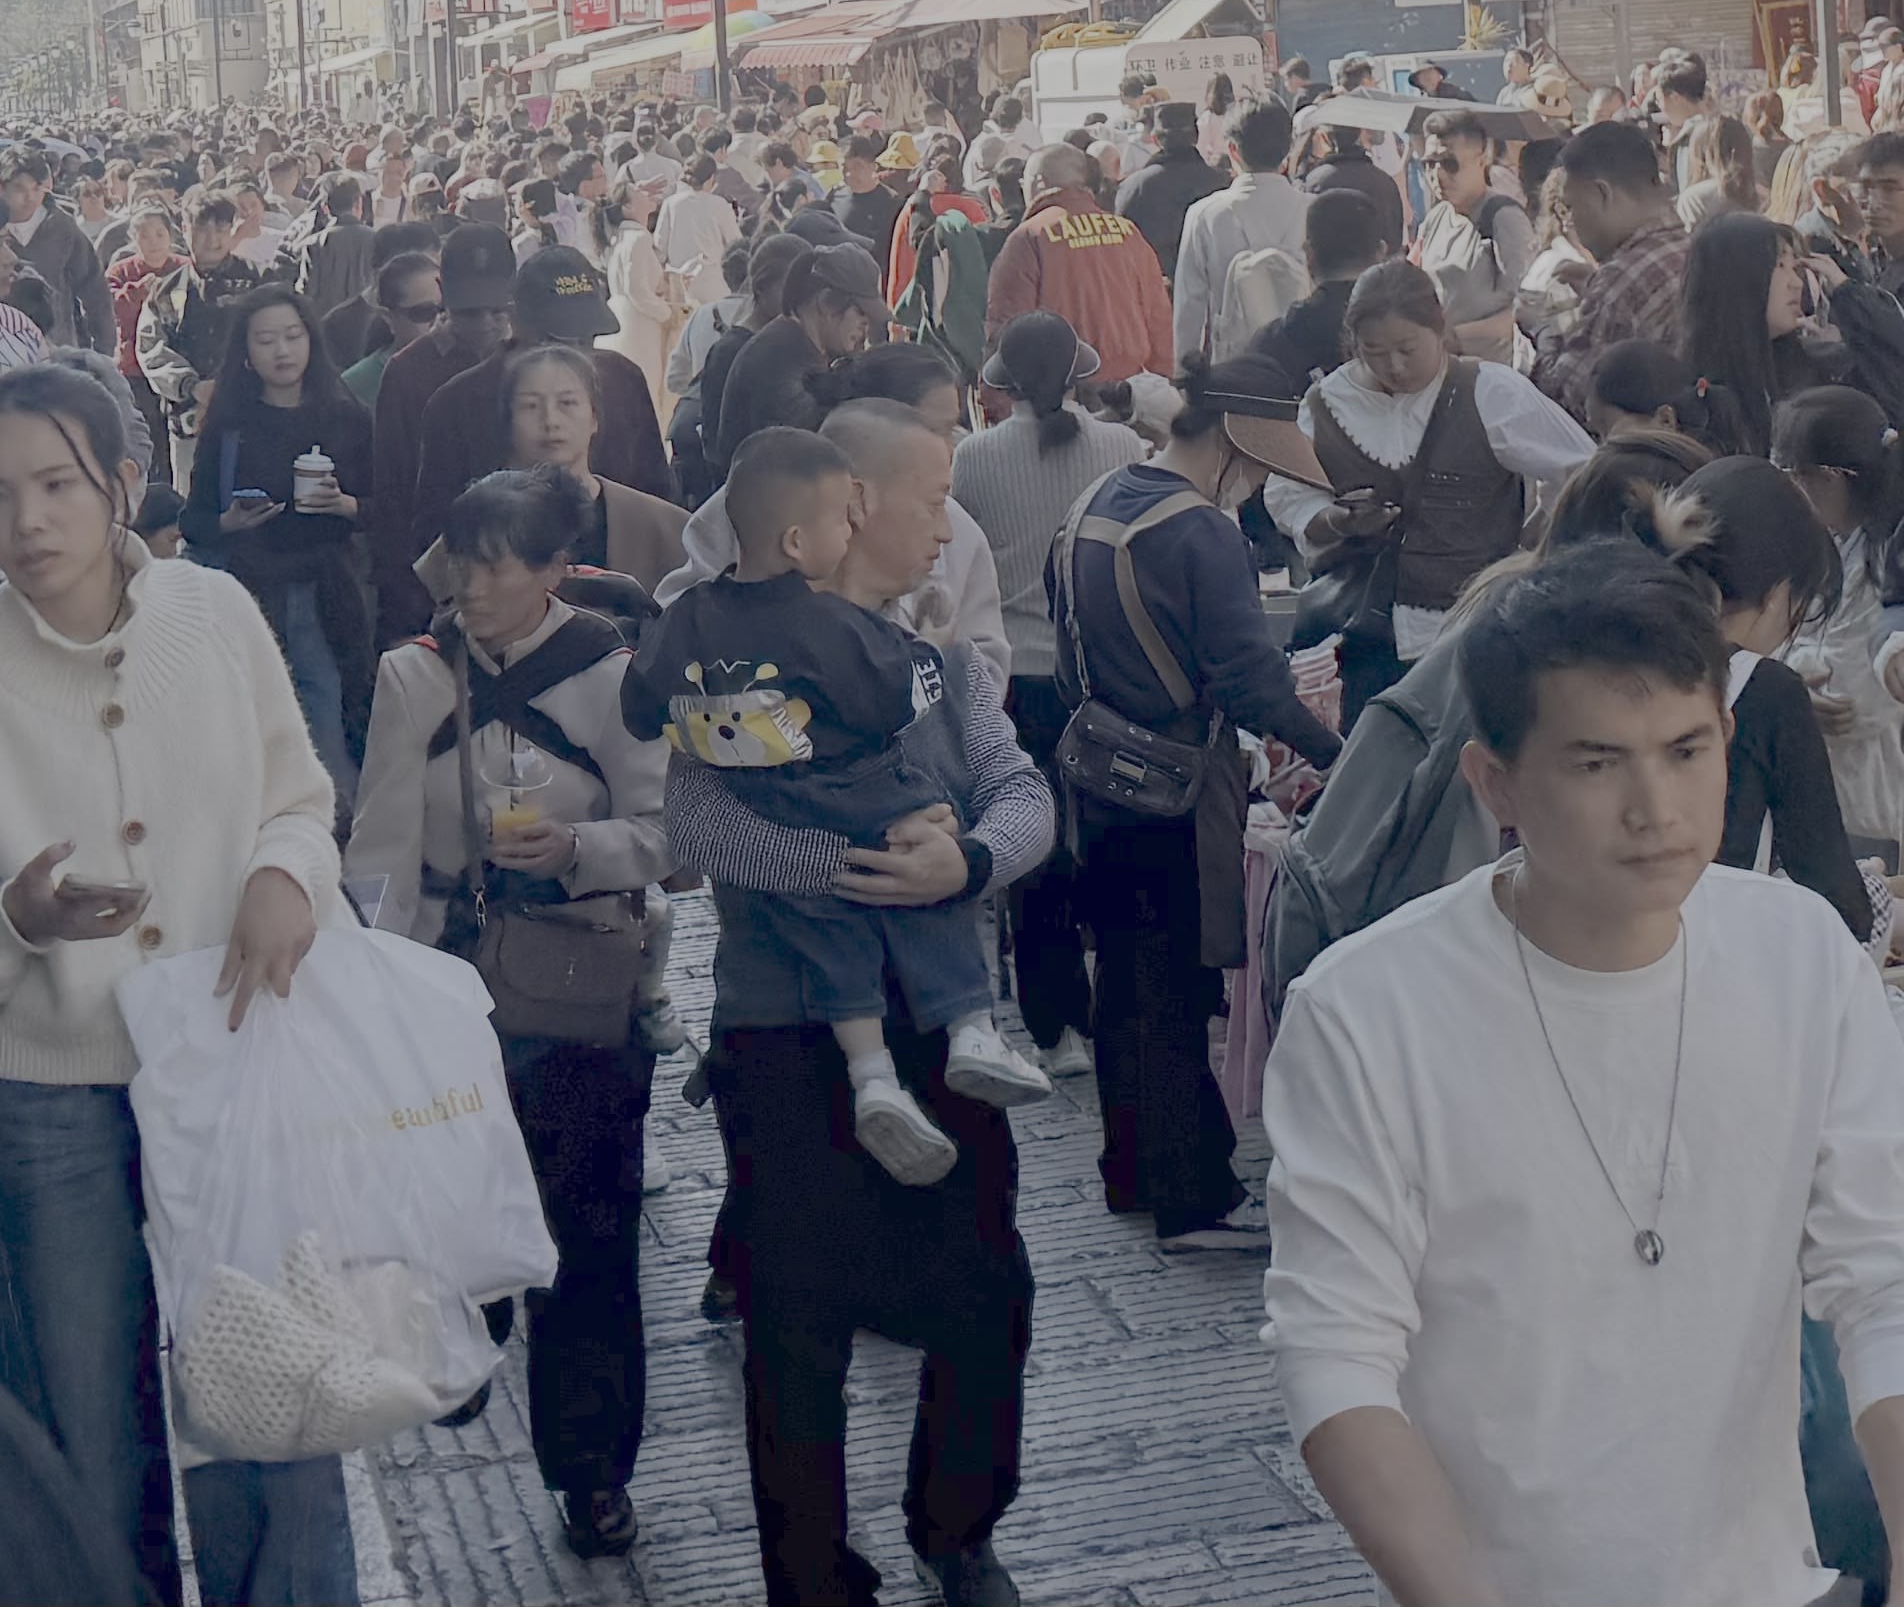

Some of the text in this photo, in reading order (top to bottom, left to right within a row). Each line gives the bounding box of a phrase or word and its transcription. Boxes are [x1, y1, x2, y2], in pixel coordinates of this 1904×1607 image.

[1164, 57, 1193, 71] 作业
[1199, 54, 1226, 70] 注意
[386, 1082, 485, 1131] eautiful
